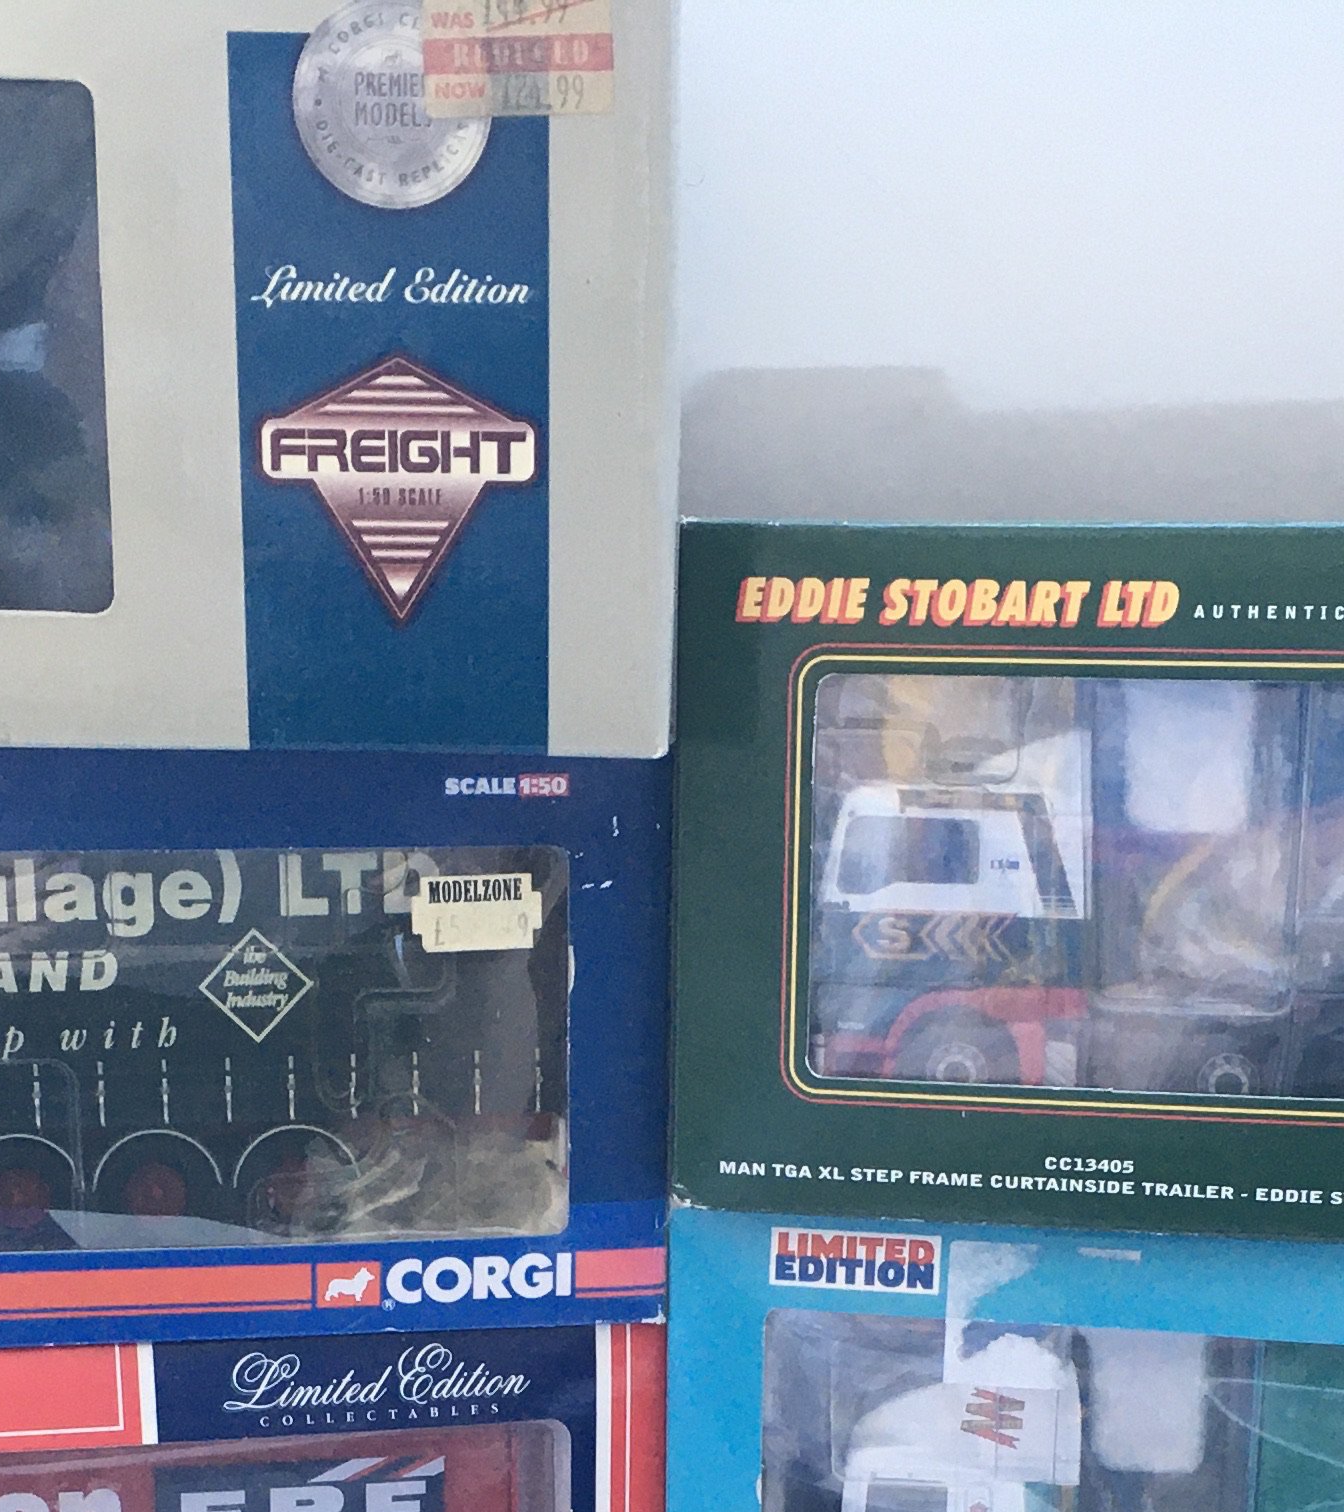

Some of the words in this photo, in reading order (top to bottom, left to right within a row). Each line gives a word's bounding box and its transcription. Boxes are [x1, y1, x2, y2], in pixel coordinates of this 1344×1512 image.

[431, 11, 475, 29] WAS
[434, 81, 488, 100] NOW
[250, 264, 397, 309] Limited
[404, 266, 532, 306] Edition
[270, 428, 528, 475] FREIGHT
[735, 576, 871, 624] EDDIE
[879, 579, 1092, 628] STOBART
[1097, 580, 1182, 628] LTD
[444, 775, 516, 796] SCALE
[518, 774, 569, 796] 1:50
[428, 877, 523, 904] MODELZONE
[223, 967, 289, 990] Building
[60, 1016, 179, 1050] with
[1044, 1155, 1136, 1174] CC13405
[719, 1160, 766, 1177] MAN
[772, 1162, 813, 1178] TGA
[817, 1164, 846, 1181] XL
[850, 1166, 904, 1184] STEP
[909, 1169, 985, 1188] FRAME
[989, 1173, 1136, 1196] CURTAINSIDE
[1142, 1180, 1235, 1200] TRAILER
[1255, 1187, 1324, 1206] EDDIE
[776, 1230, 937, 1266] LIMITED
[385, 1251, 573, 1305] CORGI
[774, 1253, 935, 1290] EDITION
[222, 1350, 389, 1413] Limited
[397, 1341, 532, 1404] Edition
[259, 1402, 500, 1428] COLLECTABLES
